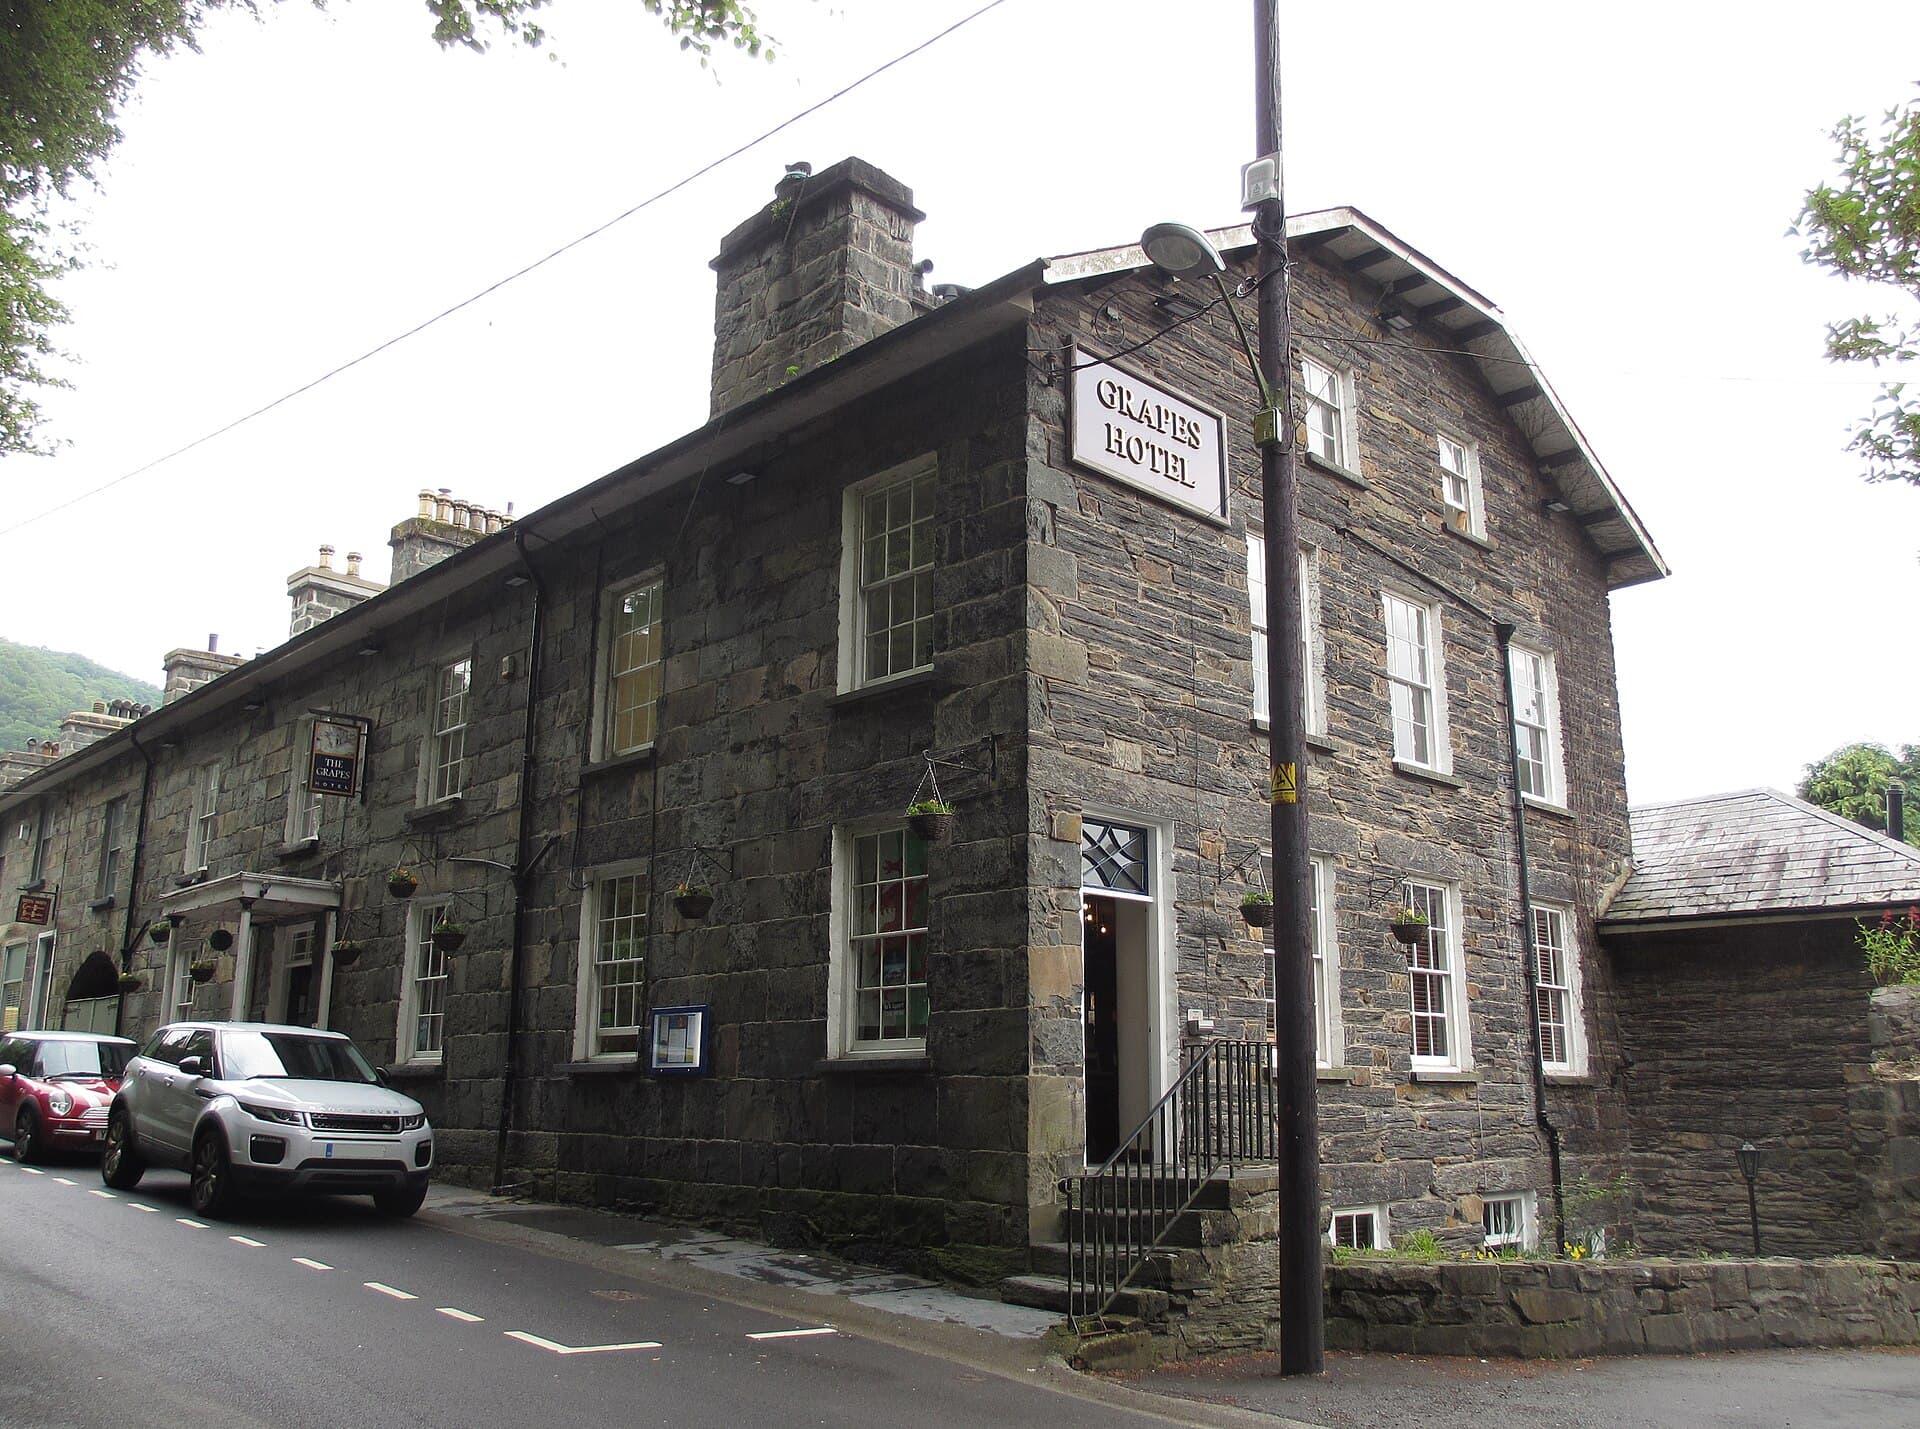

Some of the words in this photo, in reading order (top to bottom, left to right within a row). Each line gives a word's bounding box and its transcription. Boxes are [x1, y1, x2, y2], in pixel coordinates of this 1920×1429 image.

[1096, 378, 1202, 450] GRAPES
[1104, 422, 1197, 489] HOTEL
[316, 767, 351, 779] GRAPES
[325, 758, 344, 768] THE
